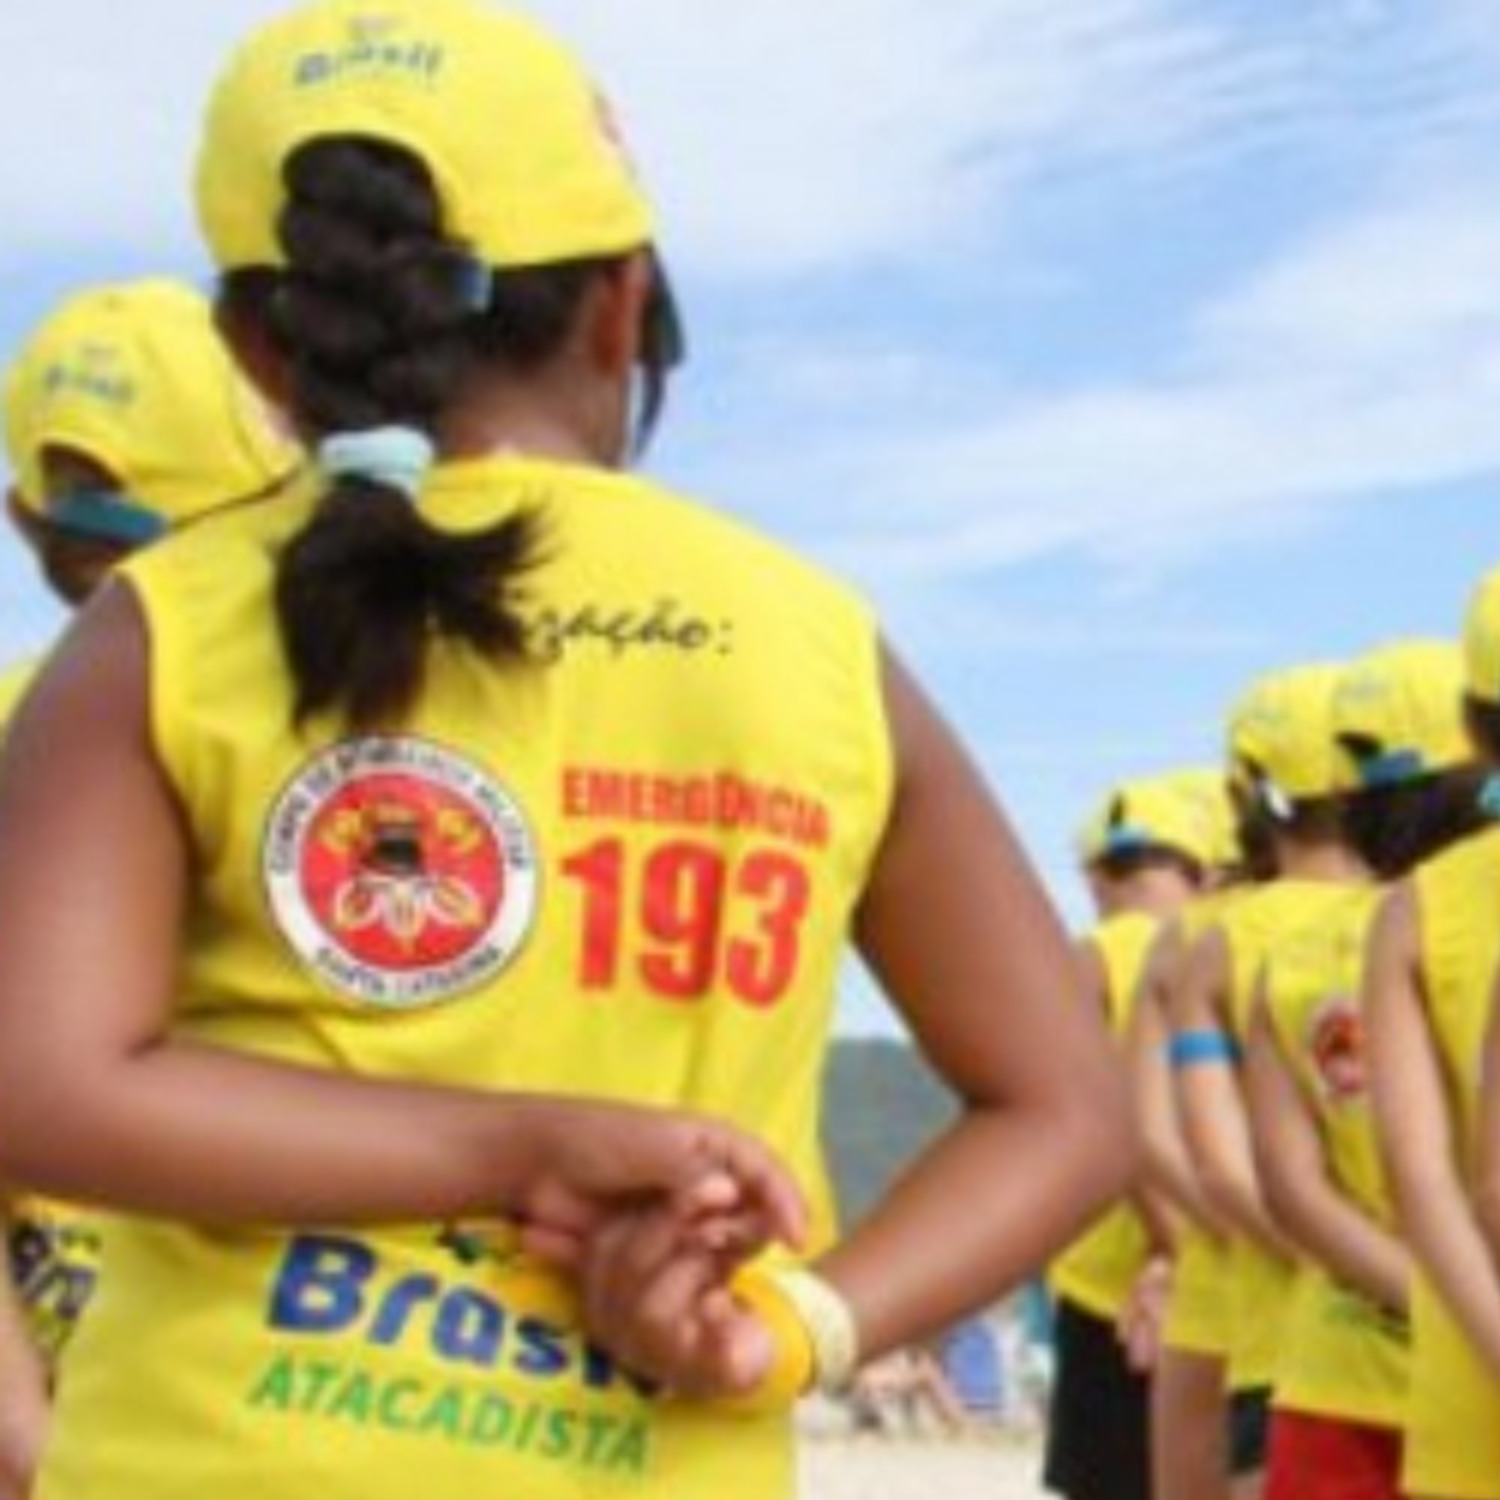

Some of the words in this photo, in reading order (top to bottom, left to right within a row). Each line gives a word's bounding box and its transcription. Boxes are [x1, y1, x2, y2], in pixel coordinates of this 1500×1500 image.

[562, 768, 830, 848] EMERGÊNCIA
[560, 836, 810, 1008] 193
[249, 1354, 652, 1474] ATACADISTA
